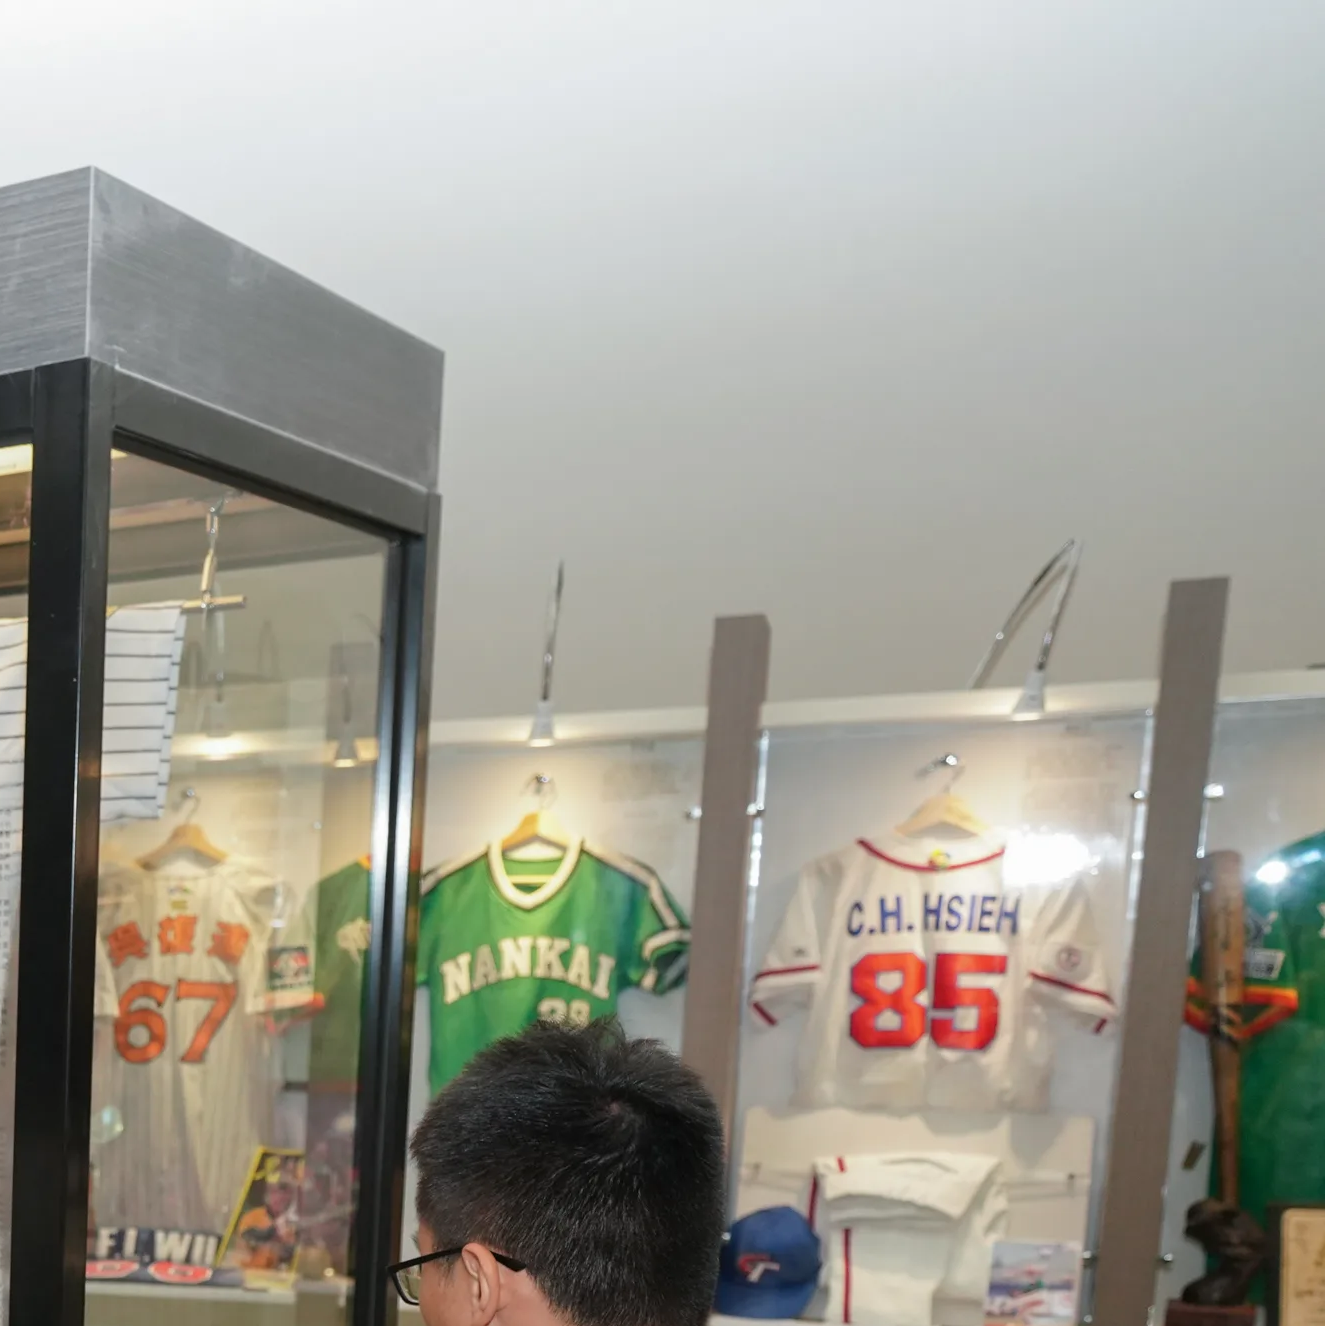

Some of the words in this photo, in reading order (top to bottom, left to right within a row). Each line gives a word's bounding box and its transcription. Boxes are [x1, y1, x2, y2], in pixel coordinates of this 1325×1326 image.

[439, 935, 616, 1005] NANKAI
[849, 952, 1007, 1051] 85
[114, 979, 239, 1064] 67
